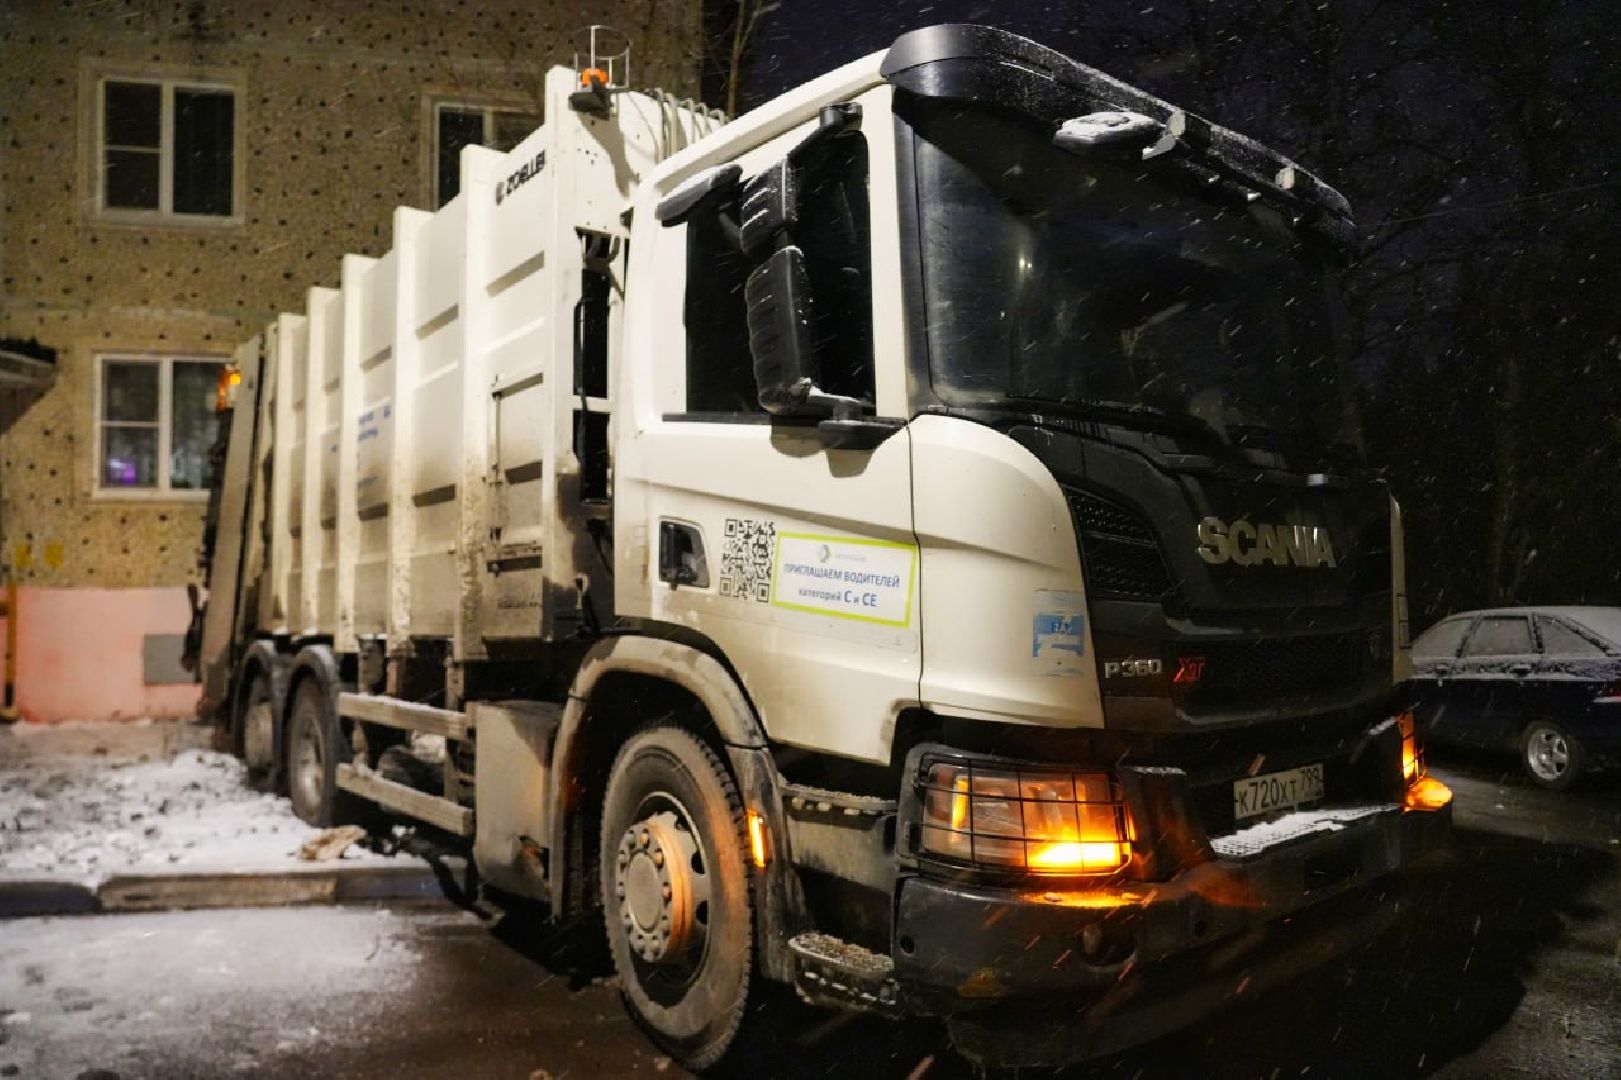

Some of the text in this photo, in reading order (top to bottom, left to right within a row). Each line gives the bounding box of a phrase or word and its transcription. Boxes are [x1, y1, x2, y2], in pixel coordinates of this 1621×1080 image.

[1197, 516, 1337, 568] SCANIA
[784, 563, 900, 588] ПРИГЛАШАЕМ ВОДИТЕЛЕЙ
[798, 587, 842, 602] категорий
